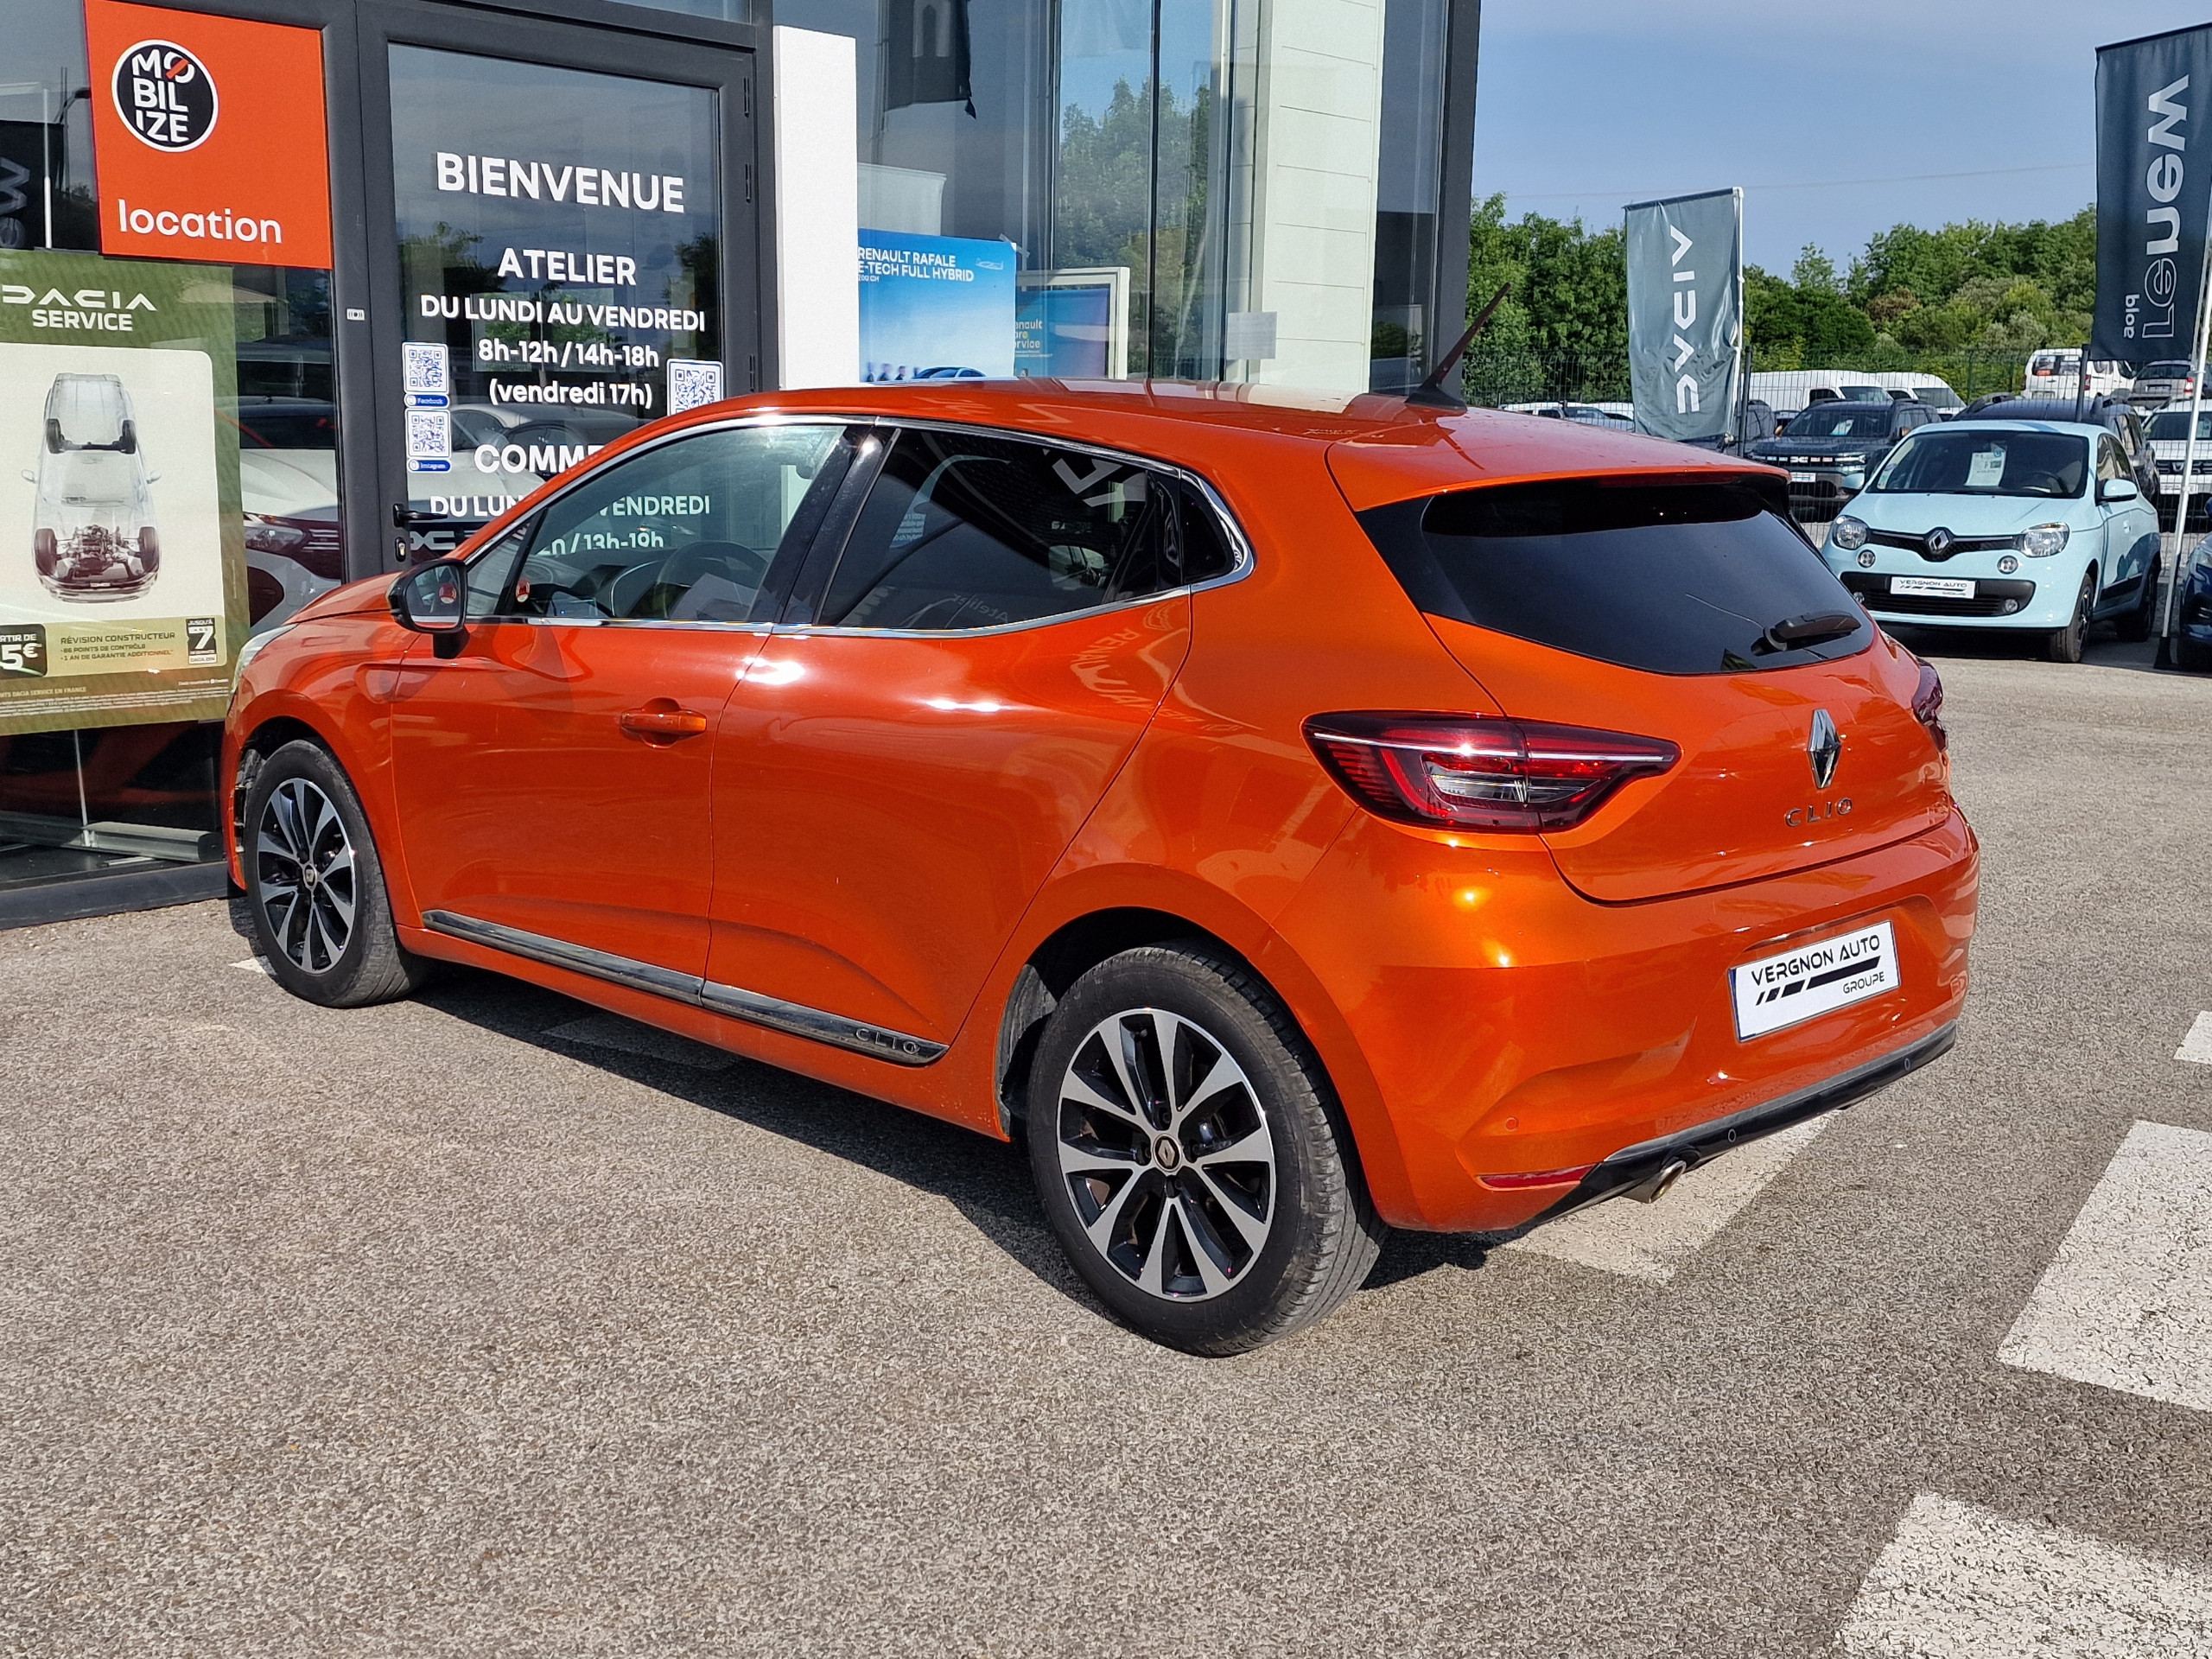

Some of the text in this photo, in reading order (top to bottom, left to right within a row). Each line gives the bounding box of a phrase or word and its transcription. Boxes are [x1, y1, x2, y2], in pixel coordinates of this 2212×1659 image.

[133, 79, 189, 112] BIL
[136, 111, 190, 143] IZE
[436, 151, 685, 214] BIENVENUE
[118, 198, 283, 245] location
[498, 247, 637, 286] ATELIER
[857, 247, 957, 267] RENAULT RAFALE
[858, 260, 975, 282] E-TECH FULL HYBRID
[1, 284, 157, 312] DACIA
[32, 308, 133, 332] SERVICE
[421, 295, 705, 332] DU LUNDI AU VENDREDI
[478, 338, 659, 368] 8h-12h / 14h-18h
[489, 378, 652, 410] (vendredi 17h)
[430, 495, 468, 518] DU
[23, 633, 37, 642] DE
[60, 632, 175, 645] RÉVISION CONSTRUCTEUR
[188, 626, 213, 651] 7
[1785, 797, 1853, 828] CLIO
[1751, 933, 1881, 986] VERGNON AUTO
[1842, 970, 1885, 995] GROUPE
[855, 1027, 921, 1055] CLIO
